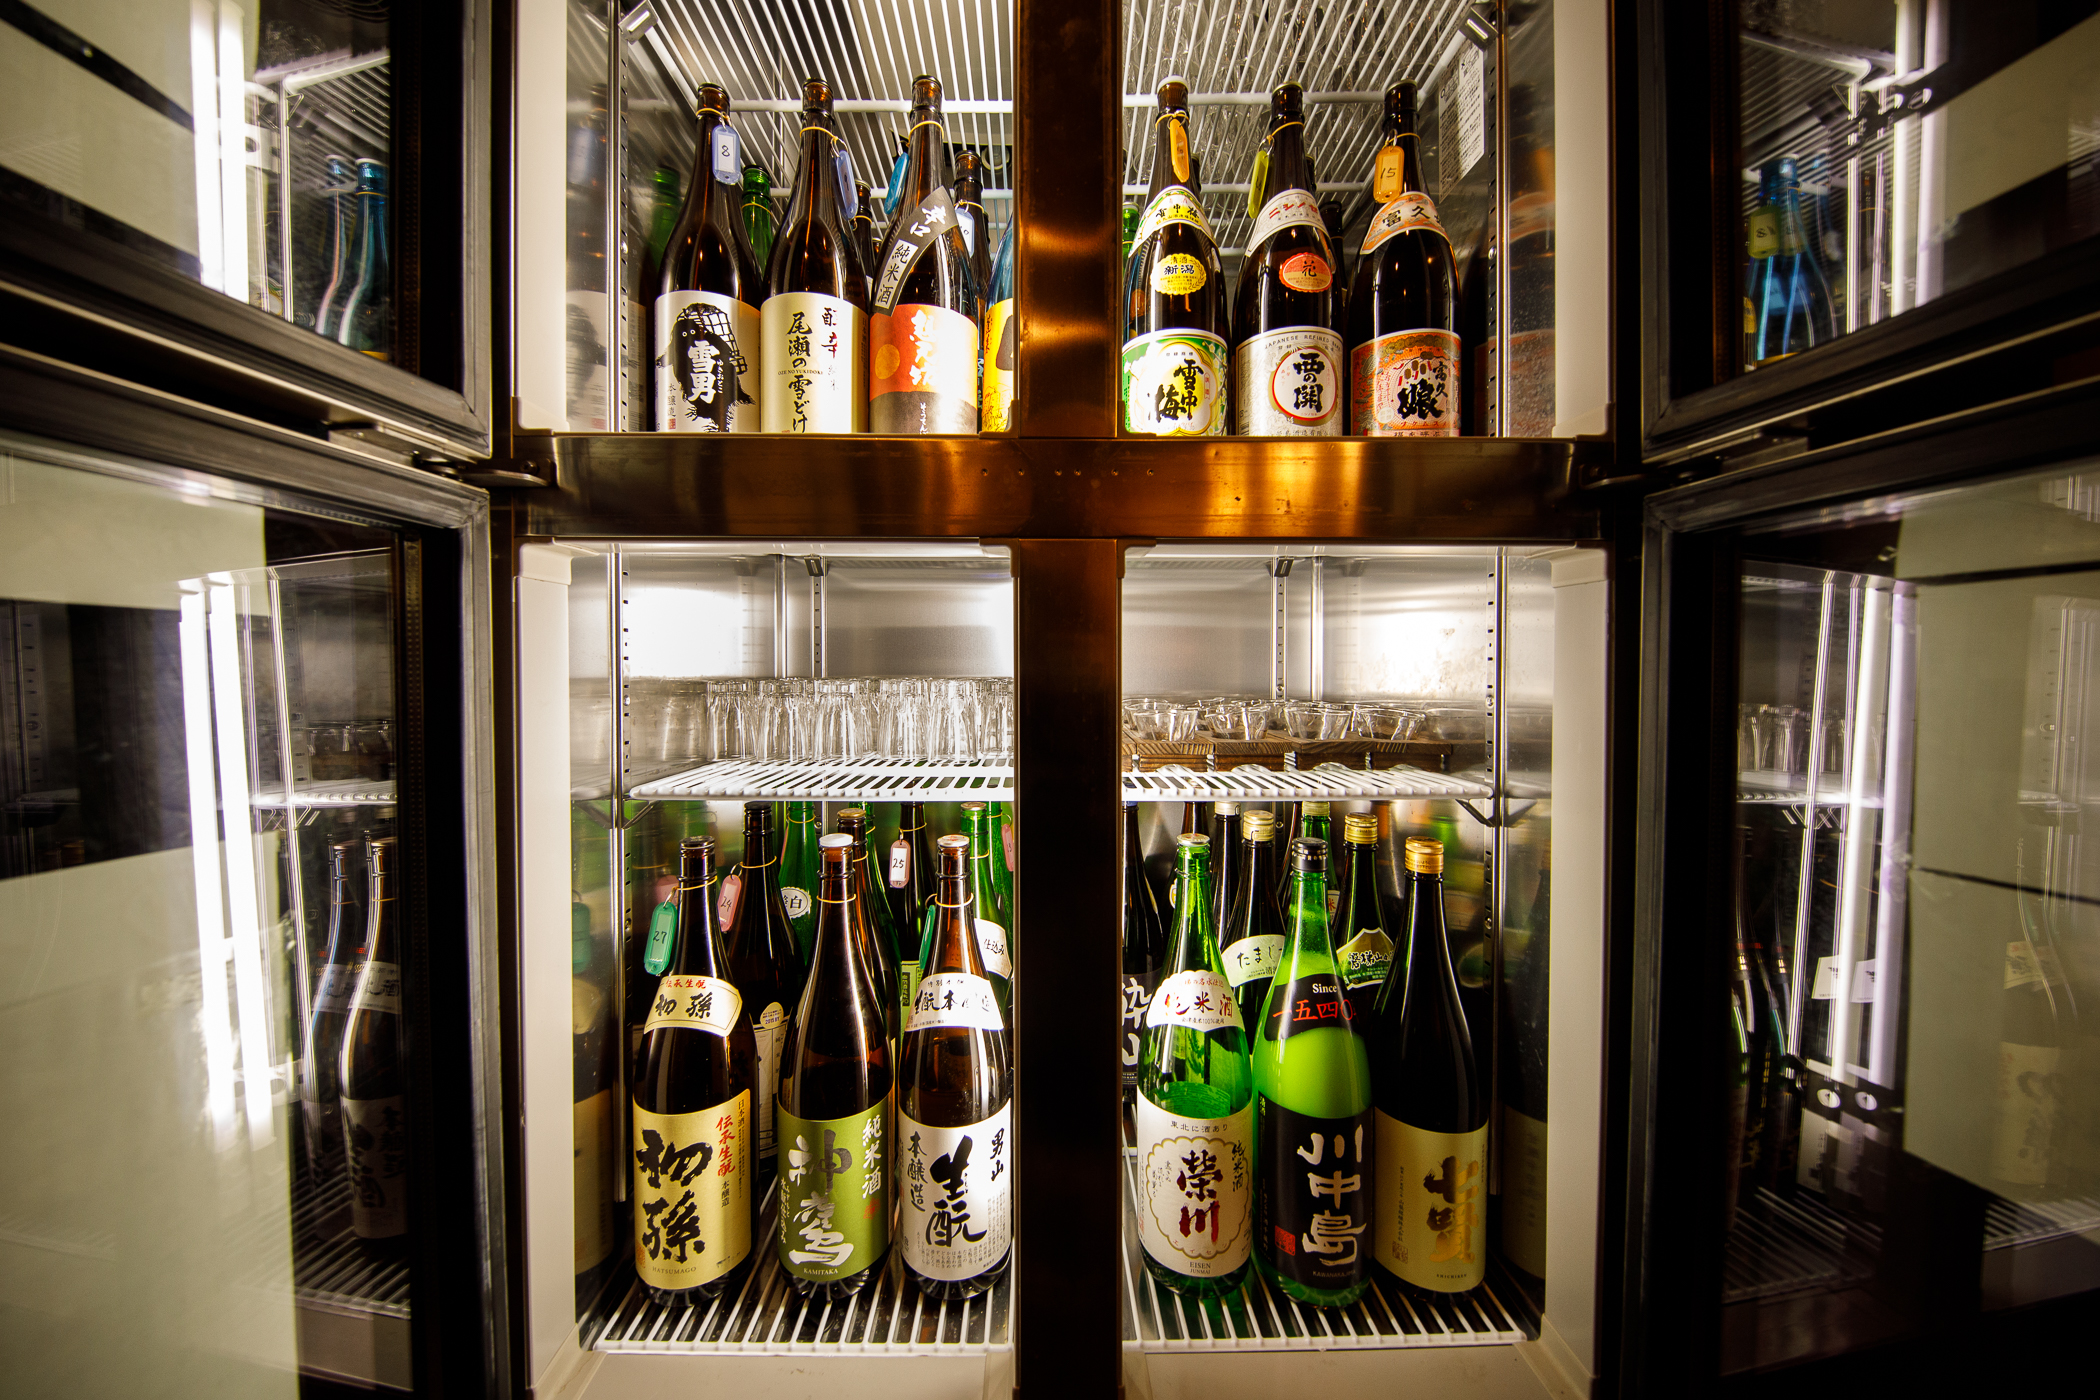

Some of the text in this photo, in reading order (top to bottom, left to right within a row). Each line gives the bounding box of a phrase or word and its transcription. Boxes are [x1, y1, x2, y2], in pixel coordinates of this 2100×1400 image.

[721, 145, 730, 157] 8
[1380, 167, 1396, 179] 15
[909, 205, 947, 237] 辛口
[878, 244, 910, 304] 純米酒
[1164, 265, 1195, 274] 新潟
[1302, 260, 1317, 277] 花
[1265, 335, 1299, 350] JAPANESE
[1304, 335, 1330, 343] REFINED
[688, 340, 720, 404] 雪男
[786, 311, 813, 433] 尾瀬の雪どけ
[892, 858, 905, 869] 25
[720, 896, 732, 912] 24
[653, 930, 667, 944] 27
[984, 938, 1005, 955] 仕込み
[1237, 944, 1283, 969] たまじ
[1312, 983, 1338, 994] Since
[655, 992, 713, 1019] 初孫
[914, 989, 991, 1016] 生酛本
[1171, 1121, 1228, 1133] 東北に酒あり
[716, 1115, 736, 1178] 伝承生酛
[862, 1114, 882, 1199] 純米酒
[990, 1128, 1005, 1182] 男山
[907, 1131, 928, 1212] 本醸造
[1232, 1140, 1247, 1192] 純米酒
[636, 1128, 713, 1264] 初孫
[788, 1129, 854, 1267] 神鷹
[926, 1135, 988, 1248] 生酛
[1297, 1124, 1367, 1267] 川中島
[652, 1266, 697, 1275] HATSUMAGO
[803, 1268, 839, 1276] KAMITAKA
[1312, 1270, 1356, 1278] KAWANAKAJIMA
